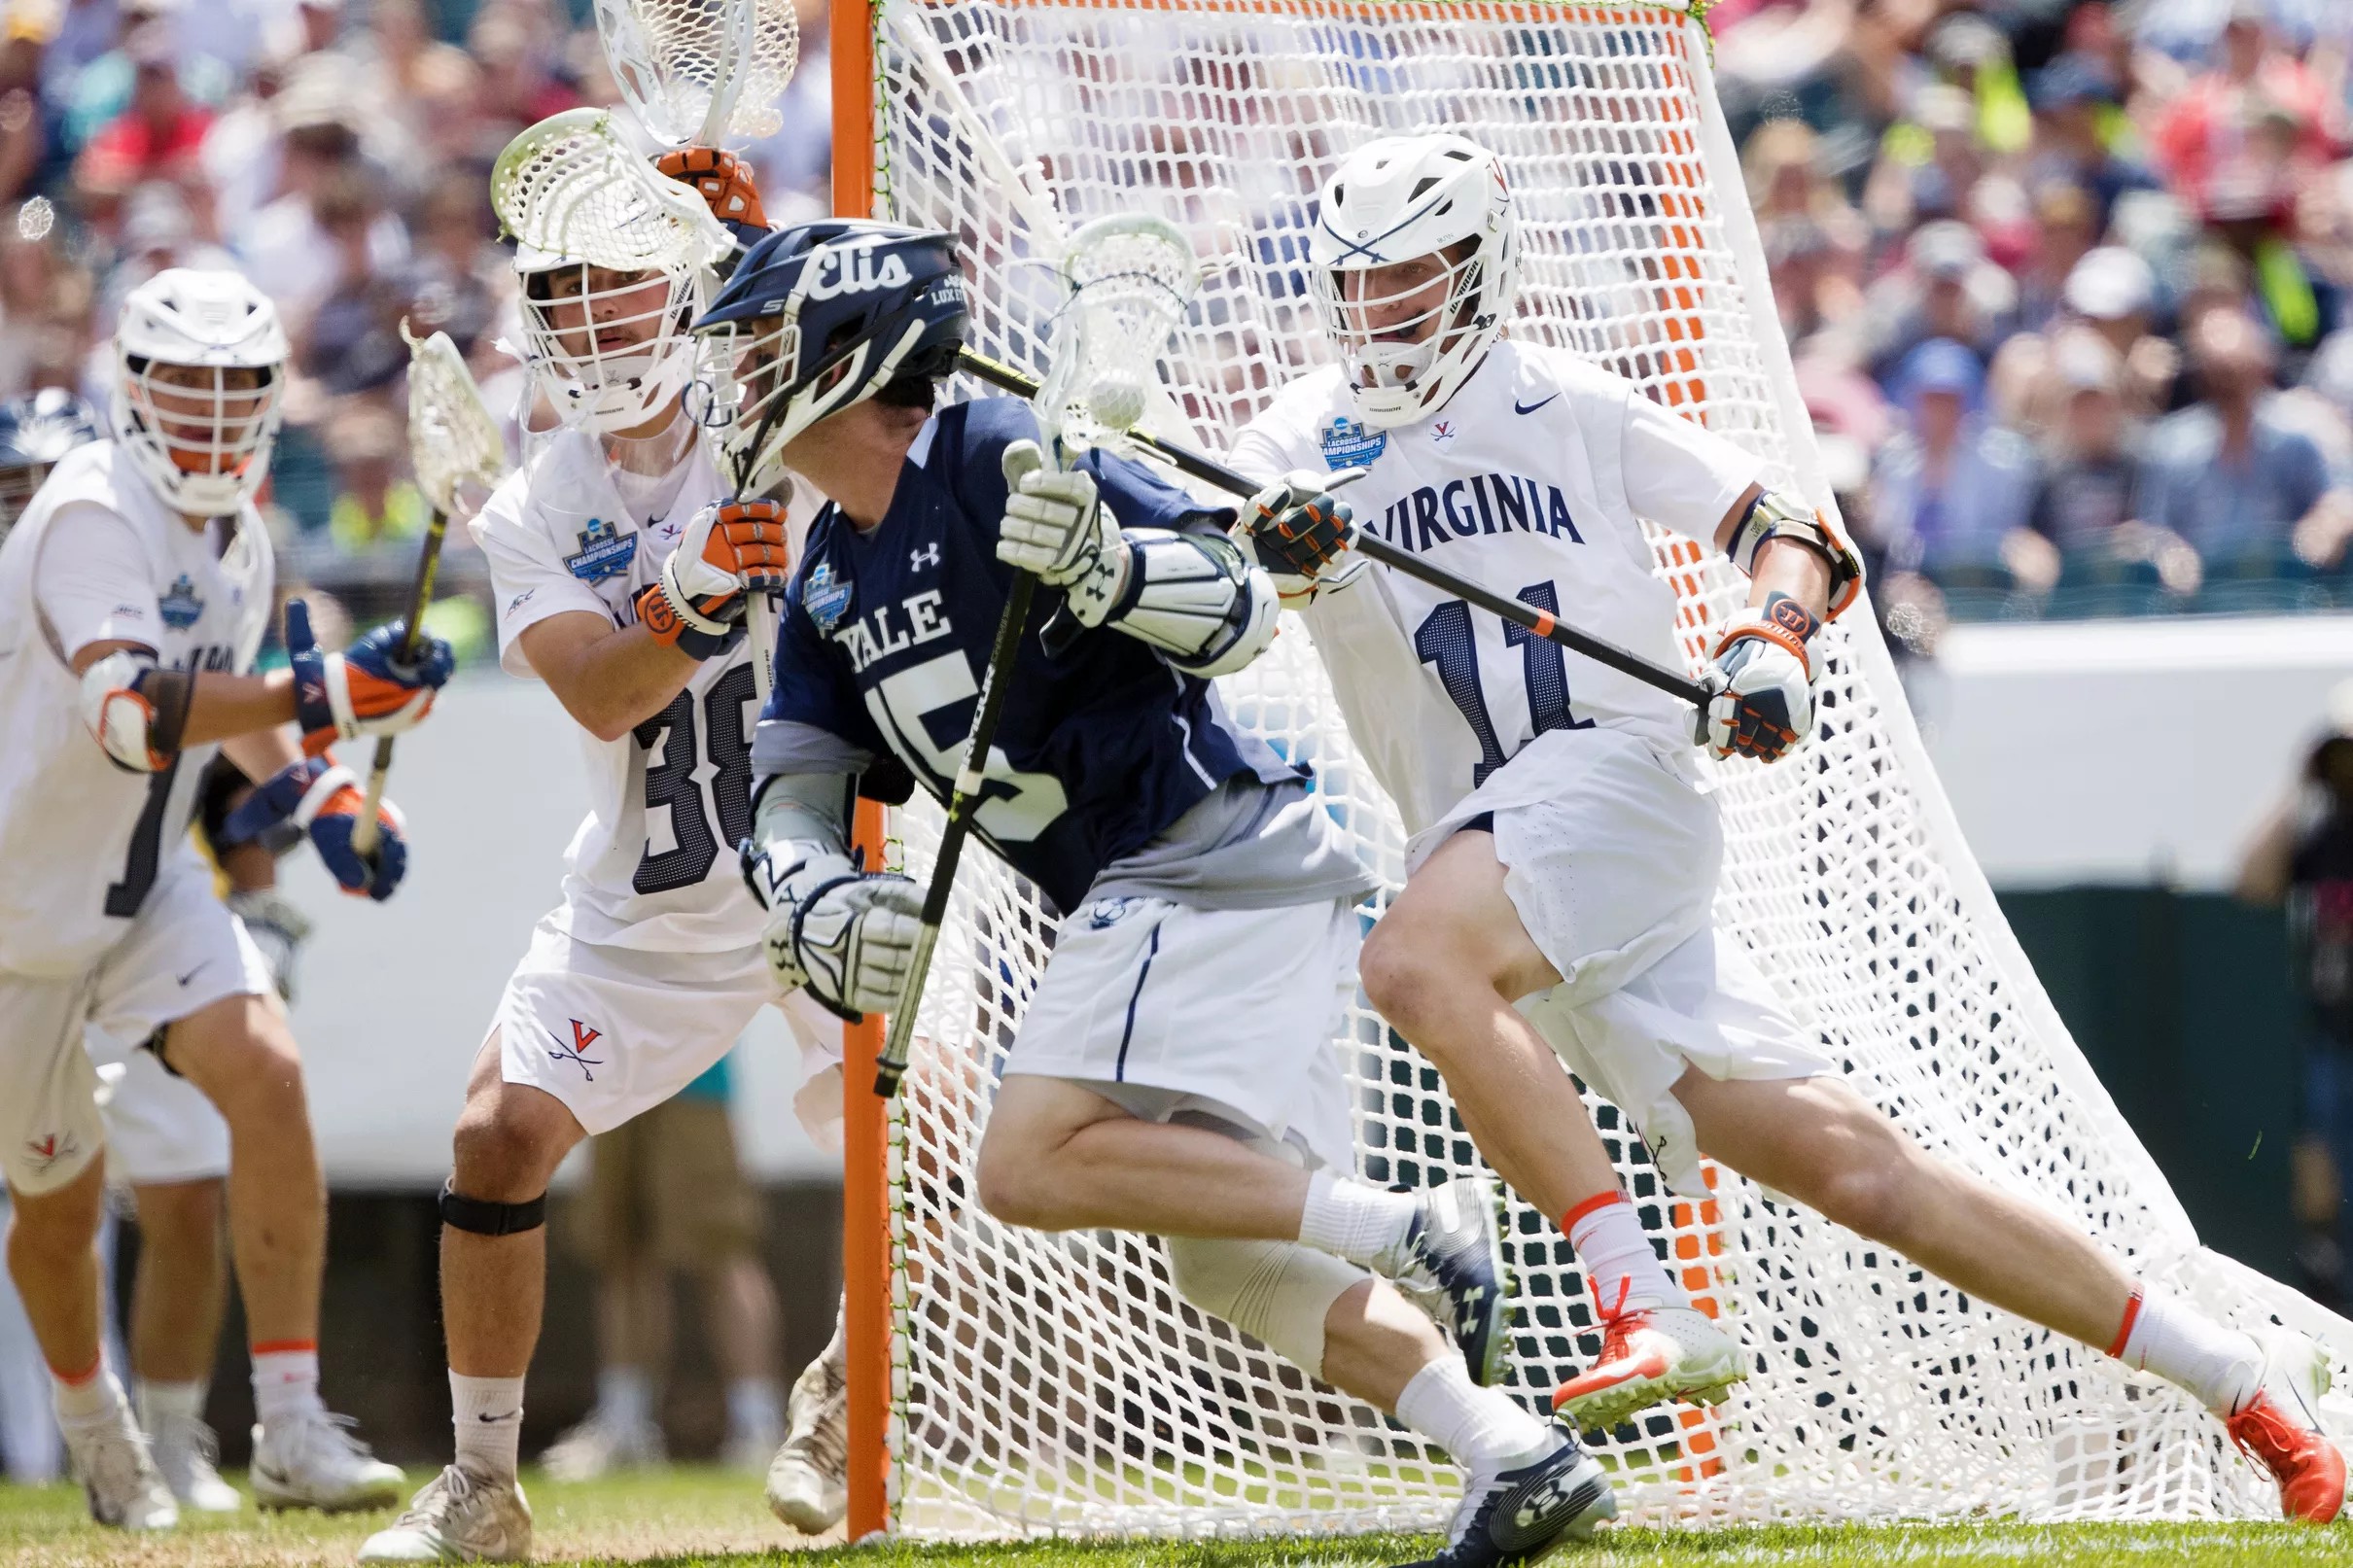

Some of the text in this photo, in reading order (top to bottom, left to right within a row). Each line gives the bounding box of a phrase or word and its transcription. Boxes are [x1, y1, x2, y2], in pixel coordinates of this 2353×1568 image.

[807, 246, 913, 301] Elis
[931, 289, 955, 305] LUX
[1323, 436, 1382, 456] AMPIONSHIPS
[1327, 436, 1362, 447] LACROSSE
[1363, 472, 1586, 572] VIRGINIA
[571, 538, 633, 570] CHAMPIONSHIPS
[832, 588, 952, 674] YALE
[1414, 579, 1596, 790] 11
